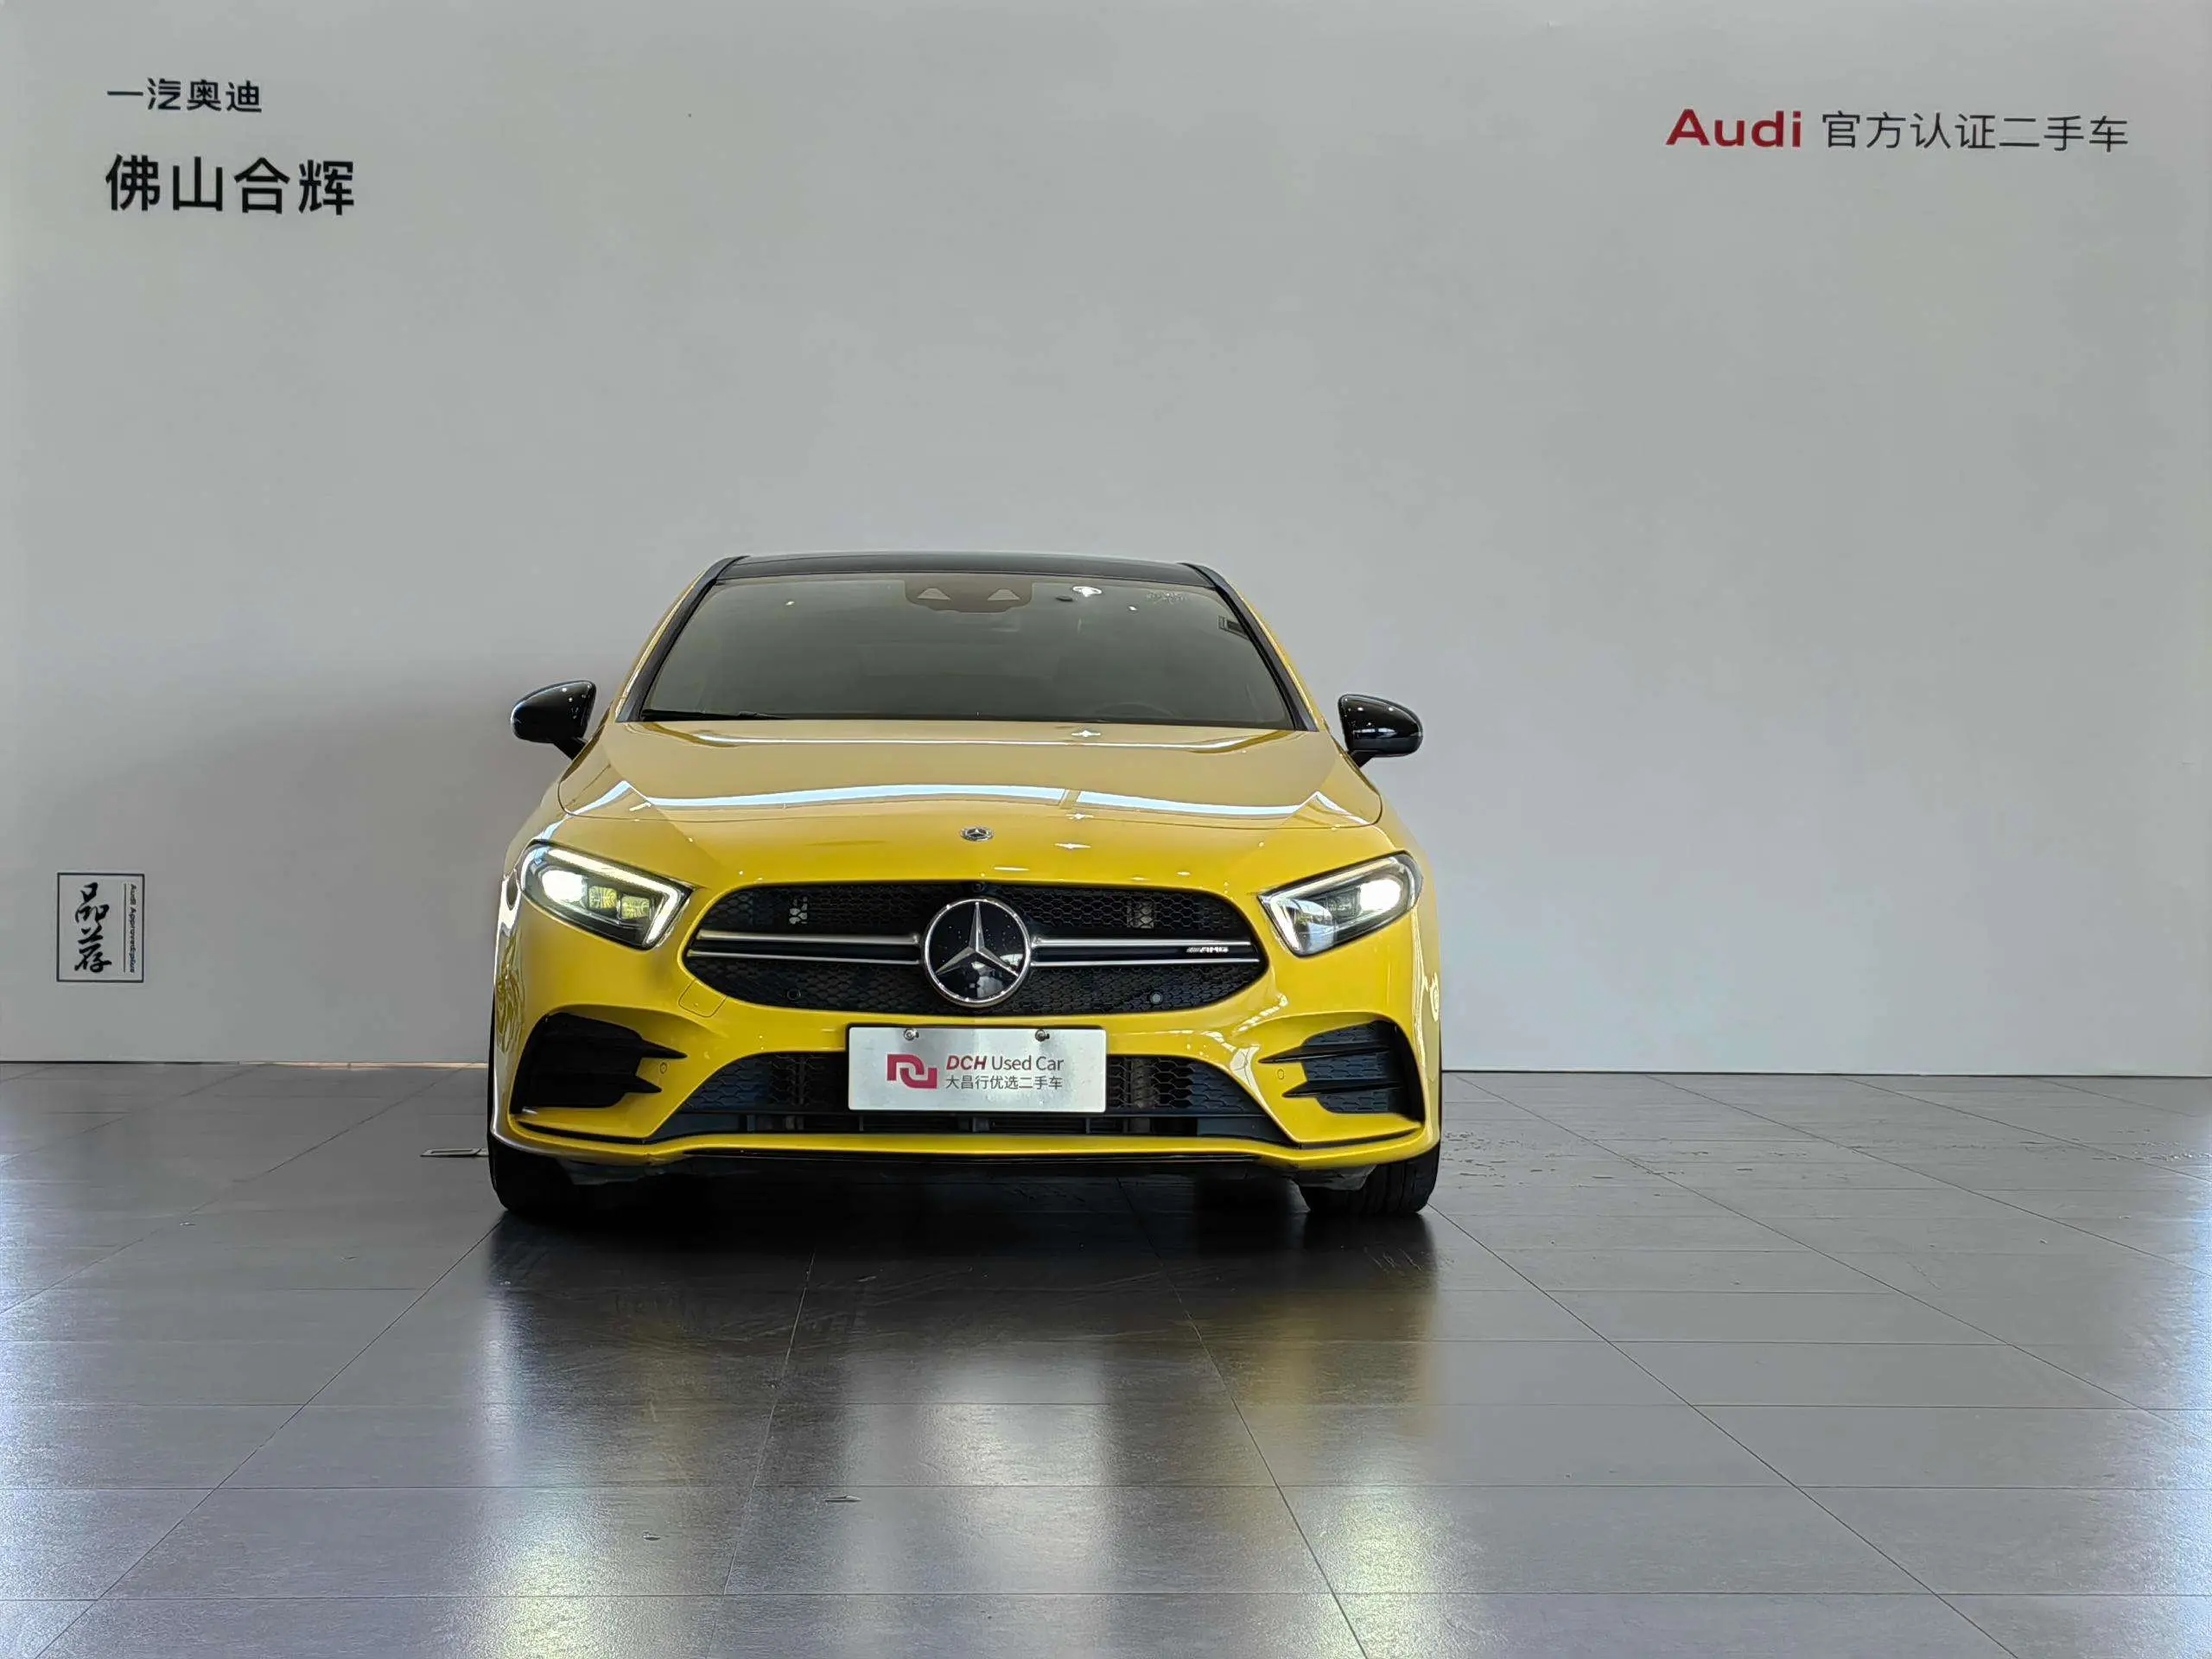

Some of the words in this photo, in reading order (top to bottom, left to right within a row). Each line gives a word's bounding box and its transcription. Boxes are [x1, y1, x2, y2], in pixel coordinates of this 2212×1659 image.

[107, 78, 263, 113] 一汽奥迪
[1666, 109, 1802, 149] Audi
[1822, 111, 2130, 153] 官方认证二手车
[105, 154, 356, 216] 佛山合辉
[946, 1055, 987, 1071] DCH
[992, 1055, 1032, 1071] Used
[1036, 1056, 1065, 1071] Car
[945, 1075, 1063, 1090] 大昌行优选二手车
